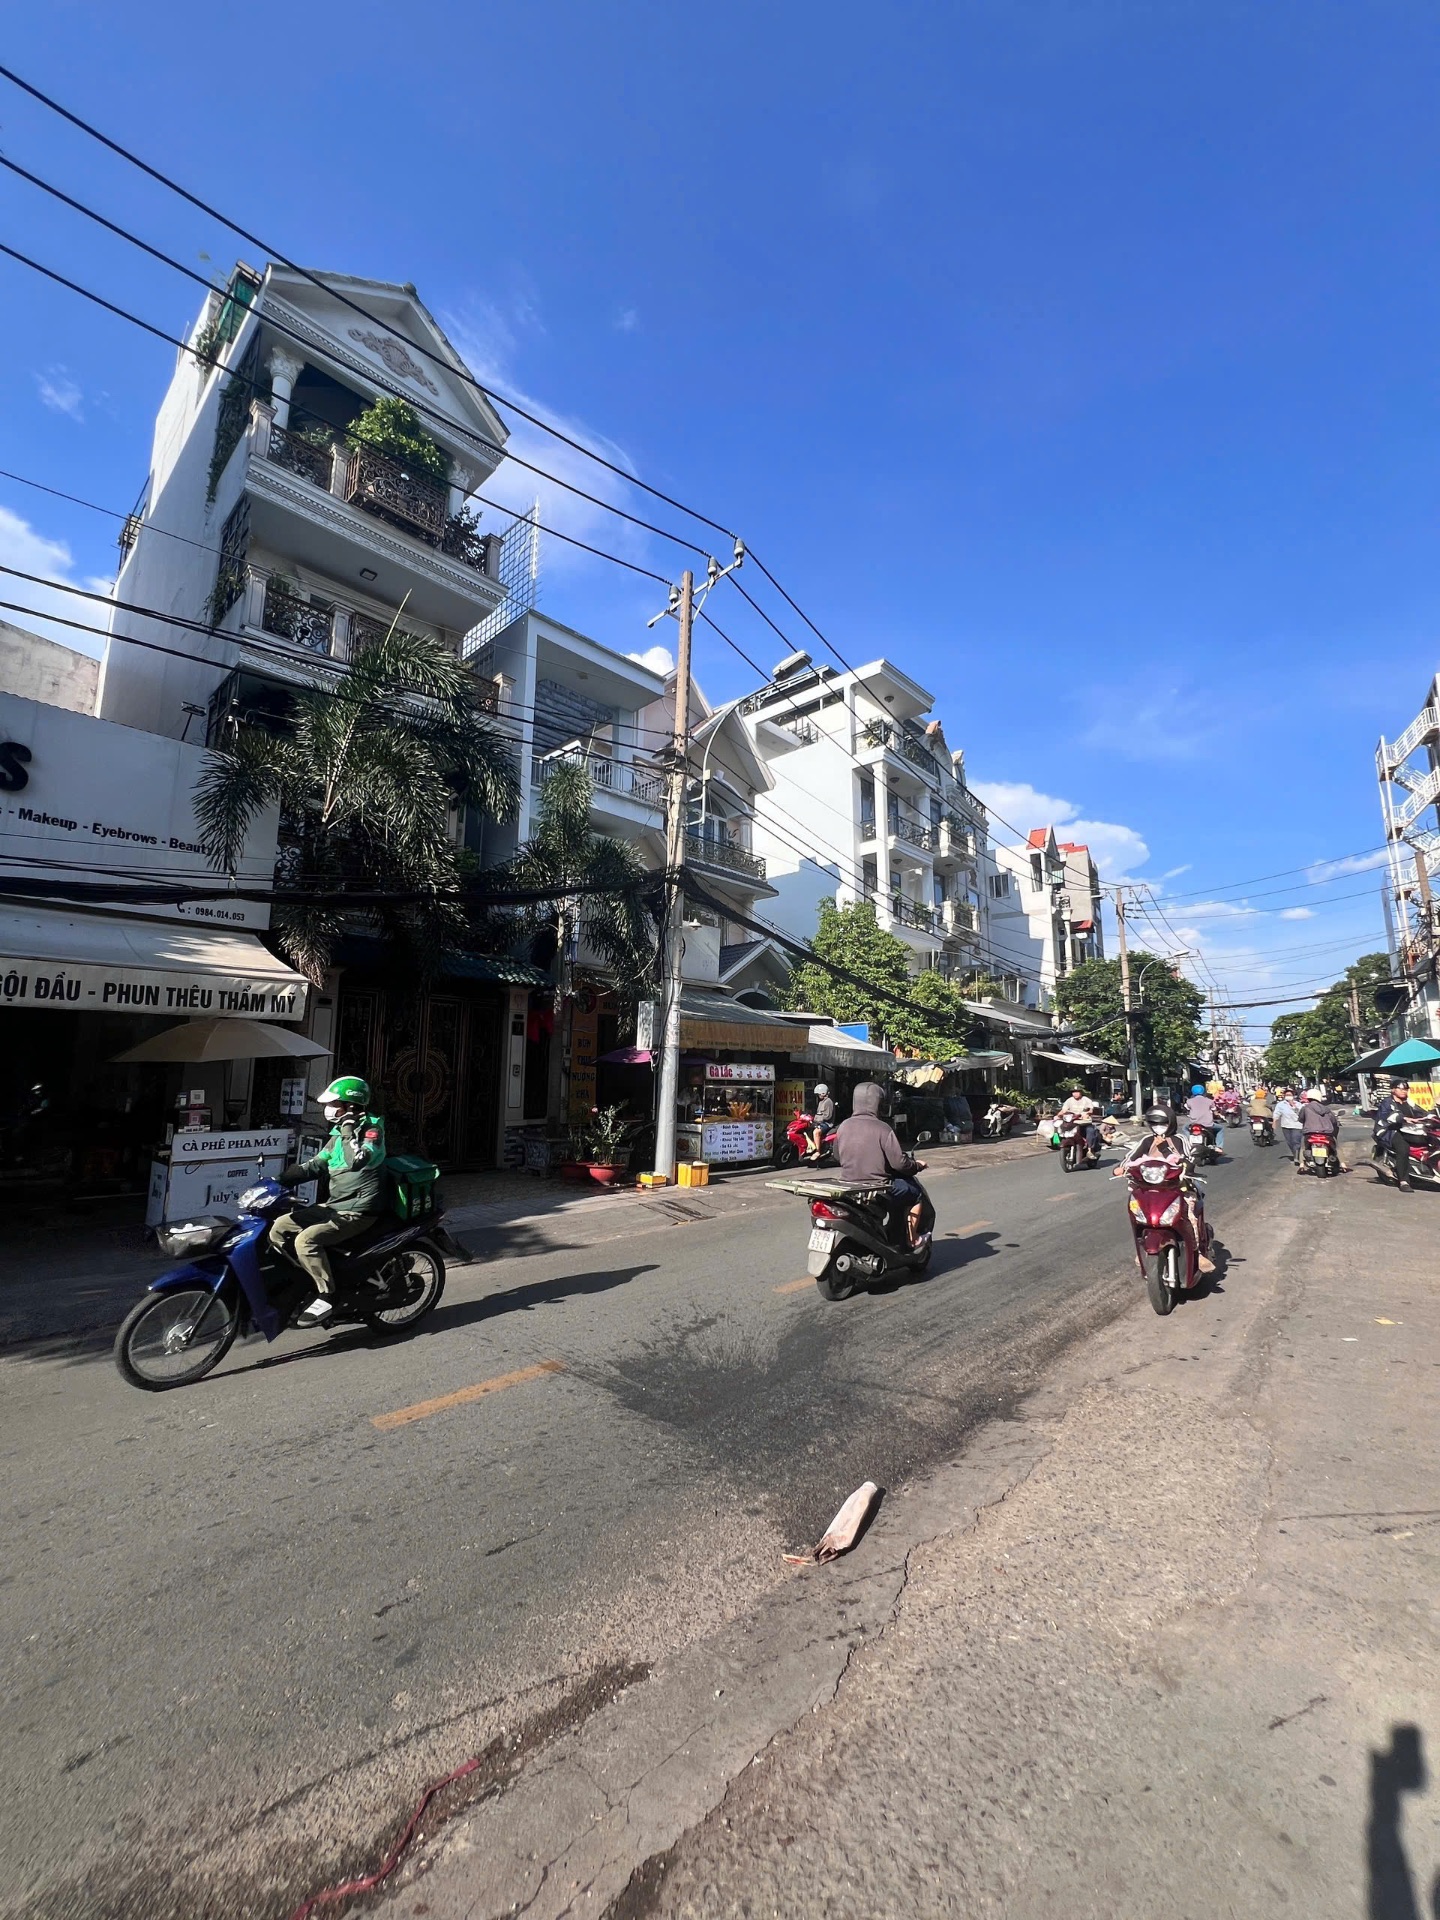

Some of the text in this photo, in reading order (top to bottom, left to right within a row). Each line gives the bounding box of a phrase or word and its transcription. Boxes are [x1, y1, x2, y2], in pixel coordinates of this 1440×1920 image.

[18, 807, 78, 831] Makeup
[92, 822, 157, 845] Eyebrows
[195, 907, 245, 921] 0984.014.053
[0, 970, 28, 1002] ỘI
[35, 971, 81, 1001] ĐẦU
[103, 982, 160, 1006] PHUN
[166, 984, 213, 1009] THÊU
[219, 985, 266, 1012] THẨM
[270, 991, 297, 1013] MỸ
[709, 1065, 720, 1078] Gà
[182, 1135, 281, 1152] CÀ PHÊ PHA MÁY
[227, 1168, 249, 1178] COFFEE
